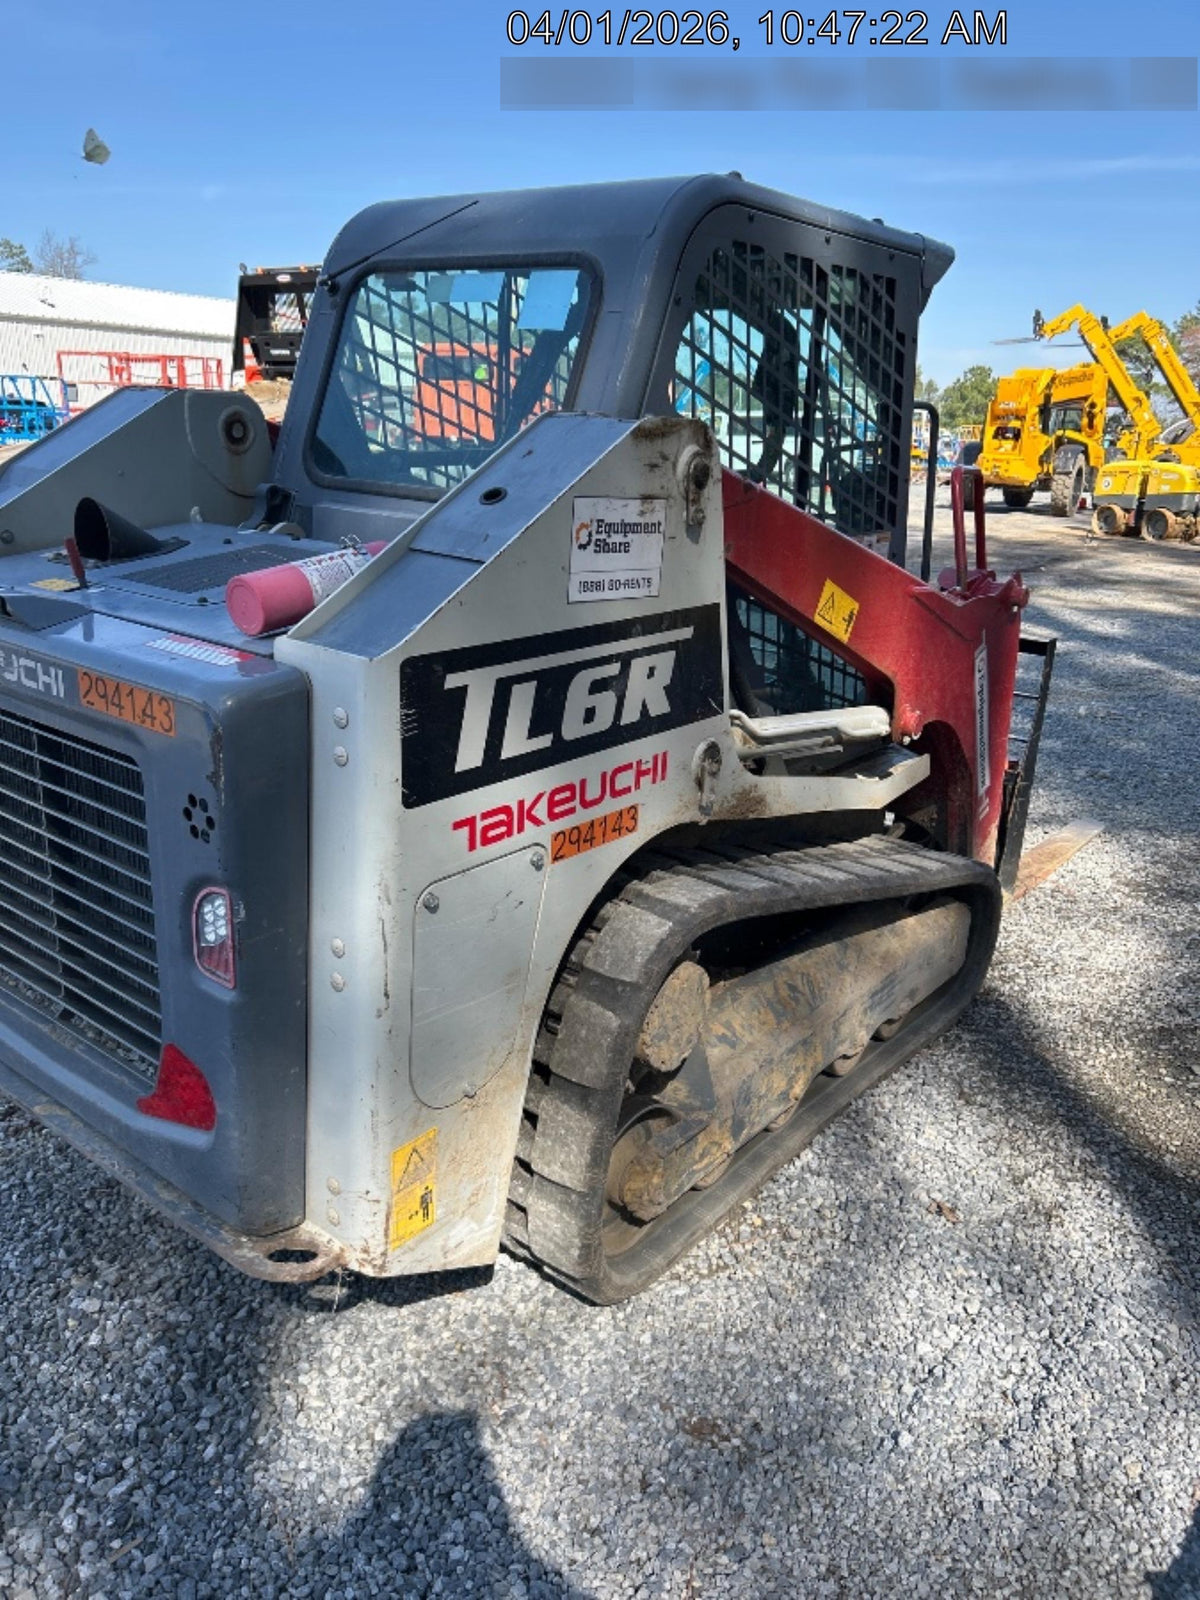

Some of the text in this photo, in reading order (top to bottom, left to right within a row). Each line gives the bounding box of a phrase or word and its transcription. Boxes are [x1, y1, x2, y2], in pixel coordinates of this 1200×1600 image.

[593, 538, 631, 554] Share
[595, 518, 662, 538] Equipment
[81, 671, 174, 734] 294143
[444, 626, 694, 774] TL6R
[452, 750, 669, 853] TAKEUCHI
[552, 805, 638, 862] 294143
